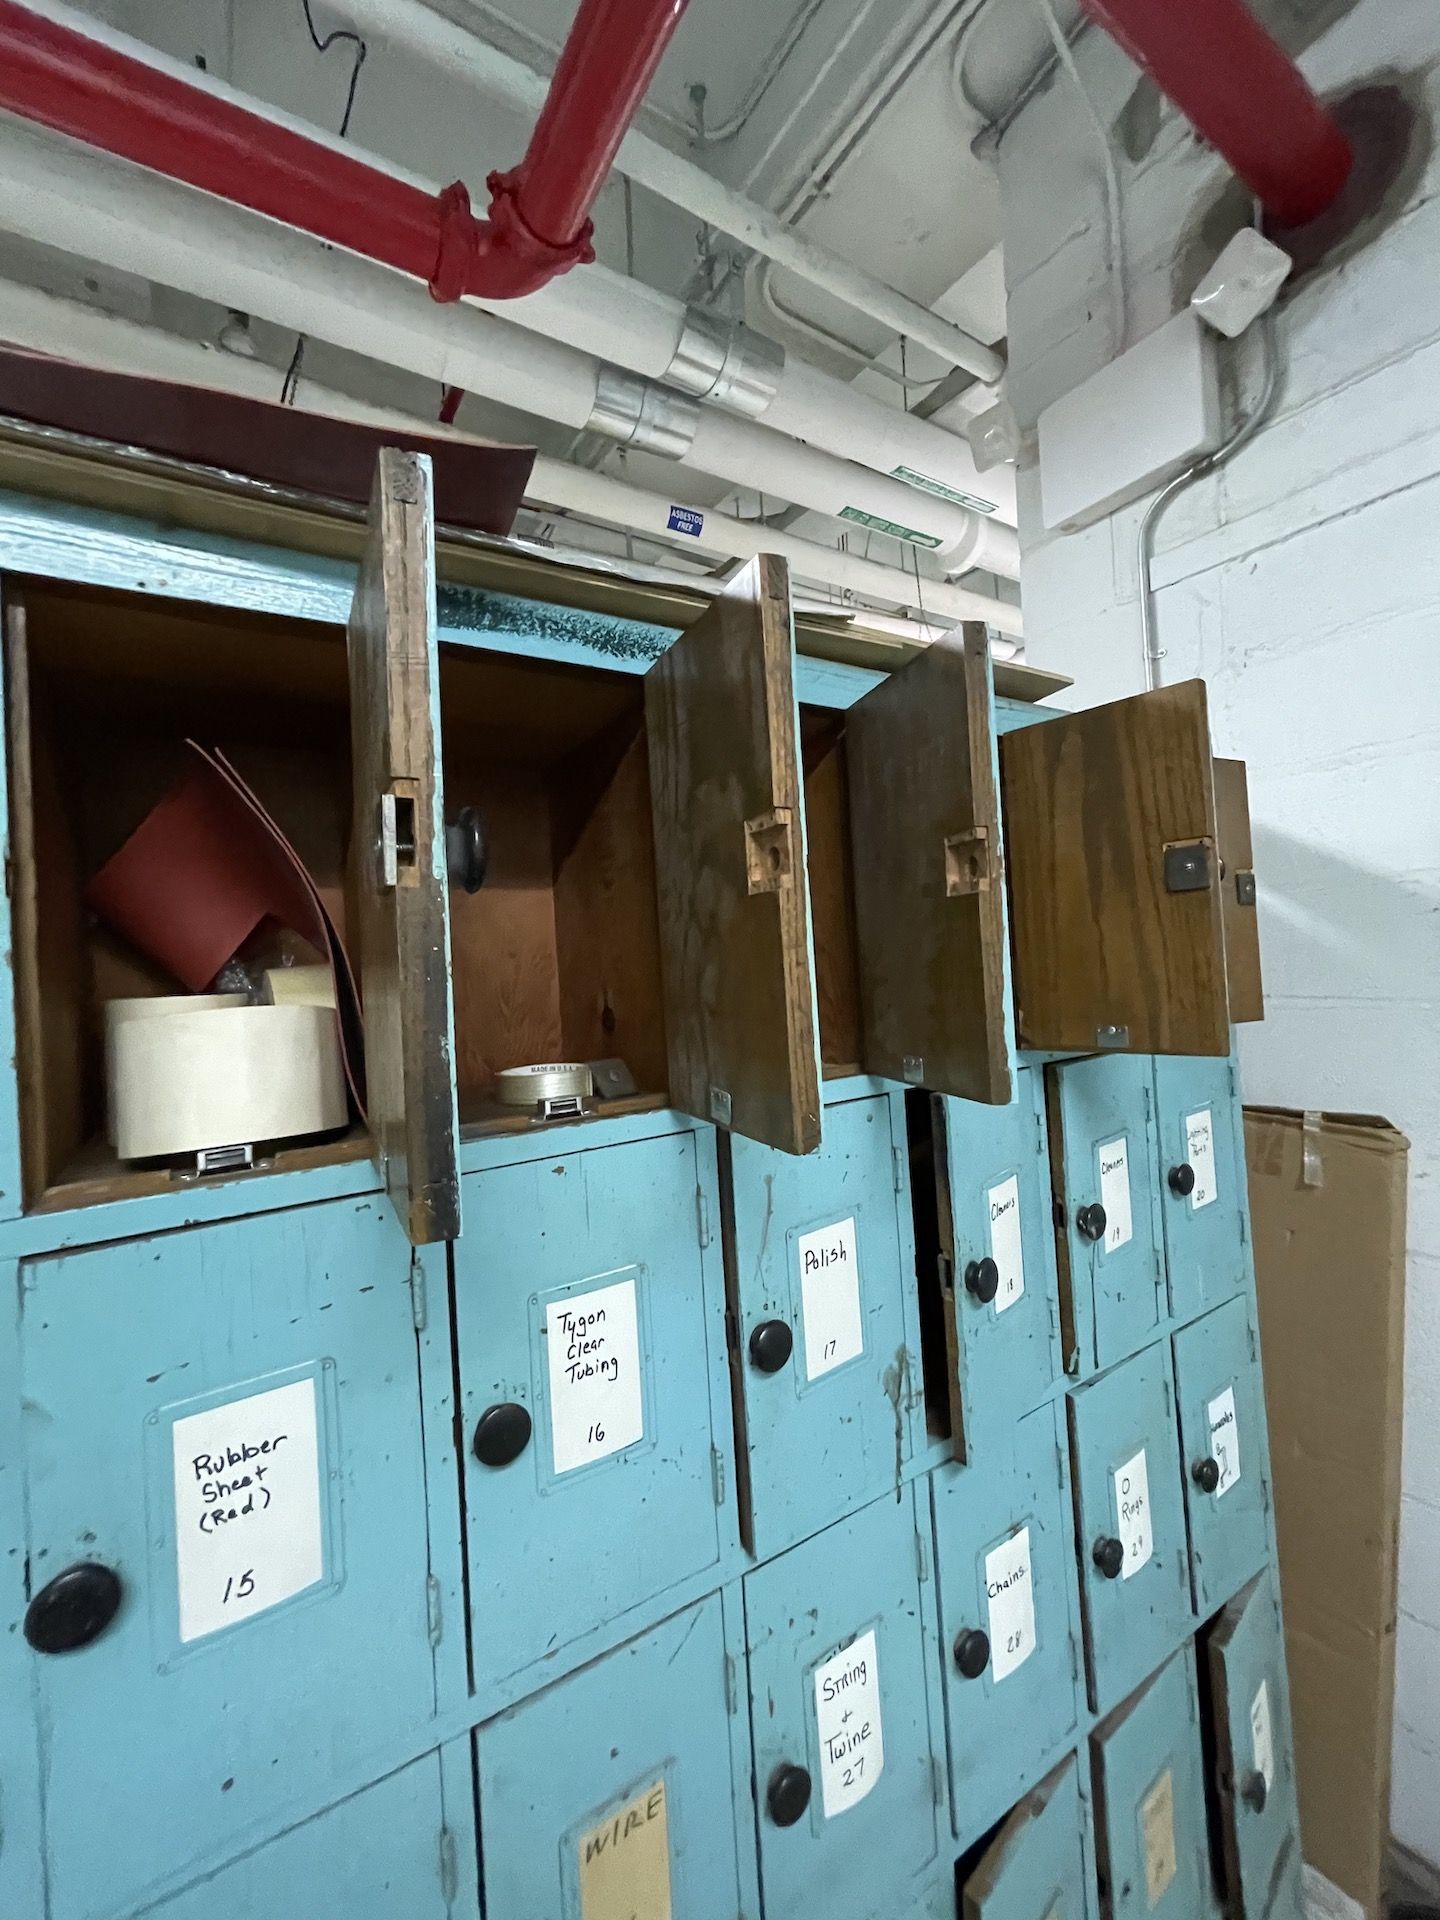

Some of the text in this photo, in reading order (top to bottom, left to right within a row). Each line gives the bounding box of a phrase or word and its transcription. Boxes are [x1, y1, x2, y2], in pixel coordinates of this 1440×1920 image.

[671, 509, 703, 526] ASBESTOS
[676, 520, 694, 532] FREE
[531, 1065, 548, 1073] MADE
[549, 1065, 556, 1073] IN
[1112, 1226, 1120, 1242] 19
[804, 1239, 847, 1275] Polish
[1006, 1278, 1014, 1293] 18
[557, 1309, 606, 1343] Tygon
[824, 1339, 836, 1360] 17
[565, 1357, 618, 1385] Tubing
[588, 1422, 605, 1443] 16
[192, 1435, 288, 1480] Rubber
[202, 1465, 269, 1503] Sheet
[199, 1487, 271, 1533] (Red)
[222, 1568, 255, 1604] 15
[987, 1565, 1026, 1599] Chains
[1007, 1629, 1022, 1653] 28
[824, 1722, 872, 1764] Twine
[842, 1757, 865, 1787] 27
[586, 1787, 663, 1865] WIRE
